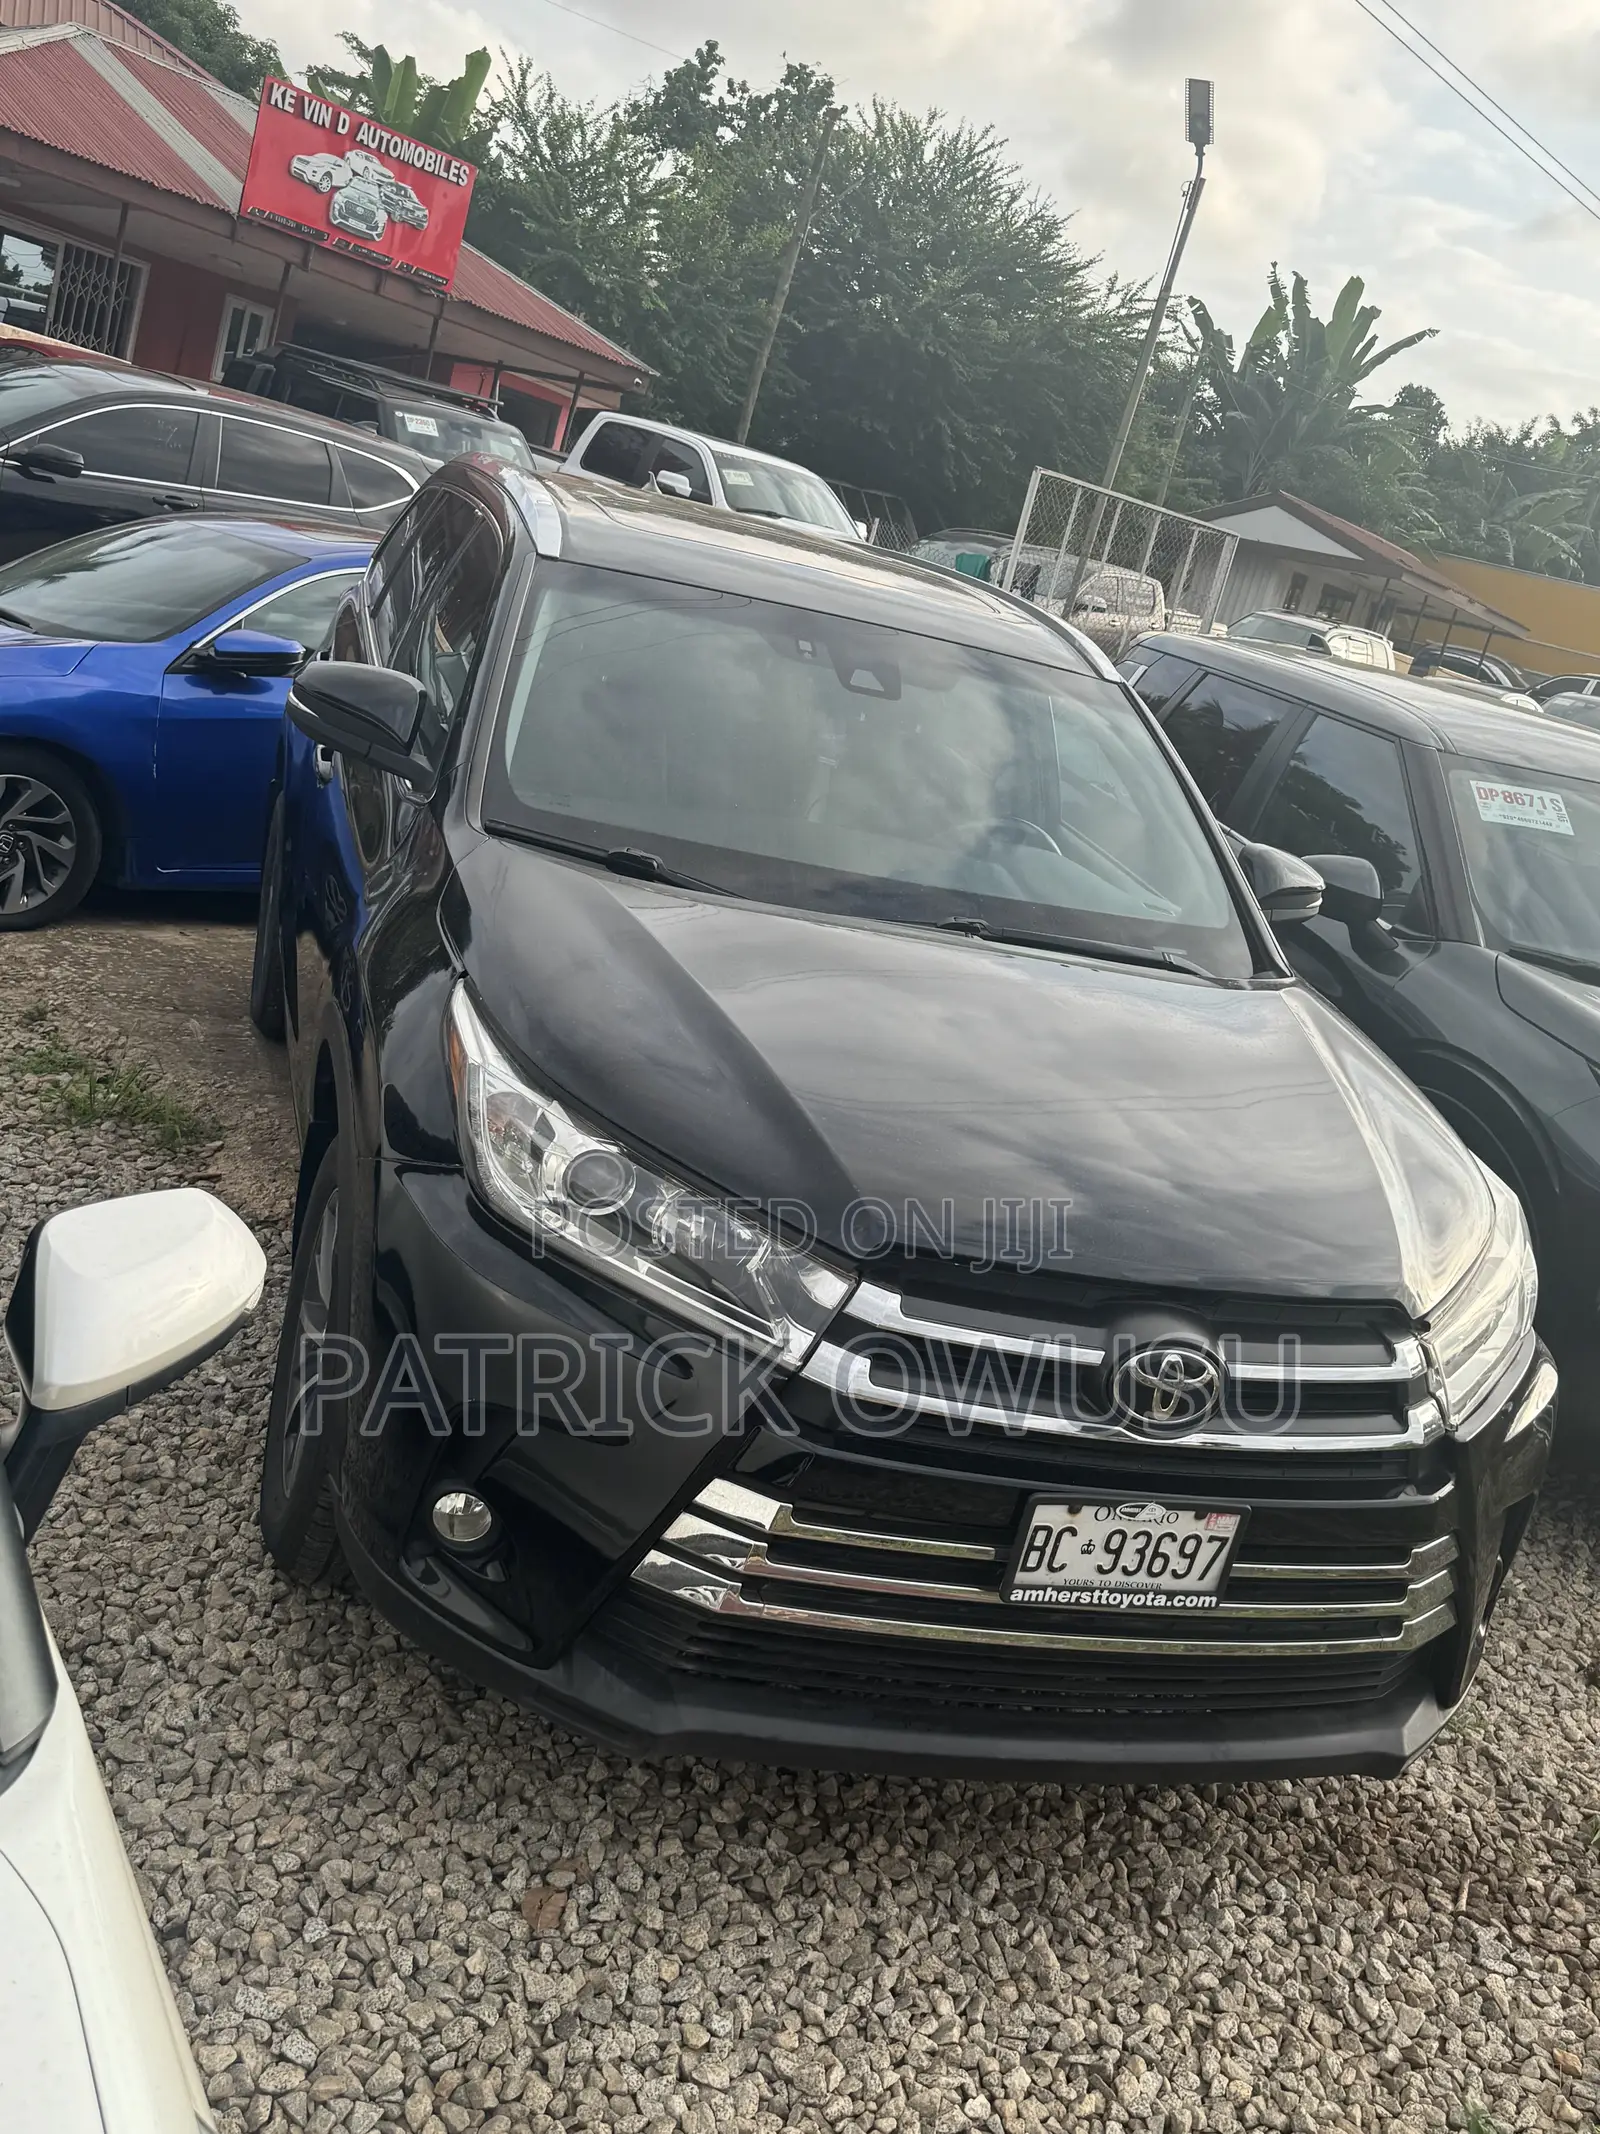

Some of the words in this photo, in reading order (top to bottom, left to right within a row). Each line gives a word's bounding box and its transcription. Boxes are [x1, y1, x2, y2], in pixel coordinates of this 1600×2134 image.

[270, 82, 297, 114] KE
[302, 95, 333, 128] VIN
[336, 111, 350, 135] D
[355, 121, 469, 187] AUTOMOBILES
[1019, 1524, 1078, 1573] BC
[1096, 1528, 1230, 1581] 93697
[1010, 1587, 1218, 1608] amhersttoyota.com
[1063, 1578, 1095, 1587] YOURS
[1099, 1579, 1112, 1587] TO
[1114, 1580, 1162, 1590] DISCOVER
